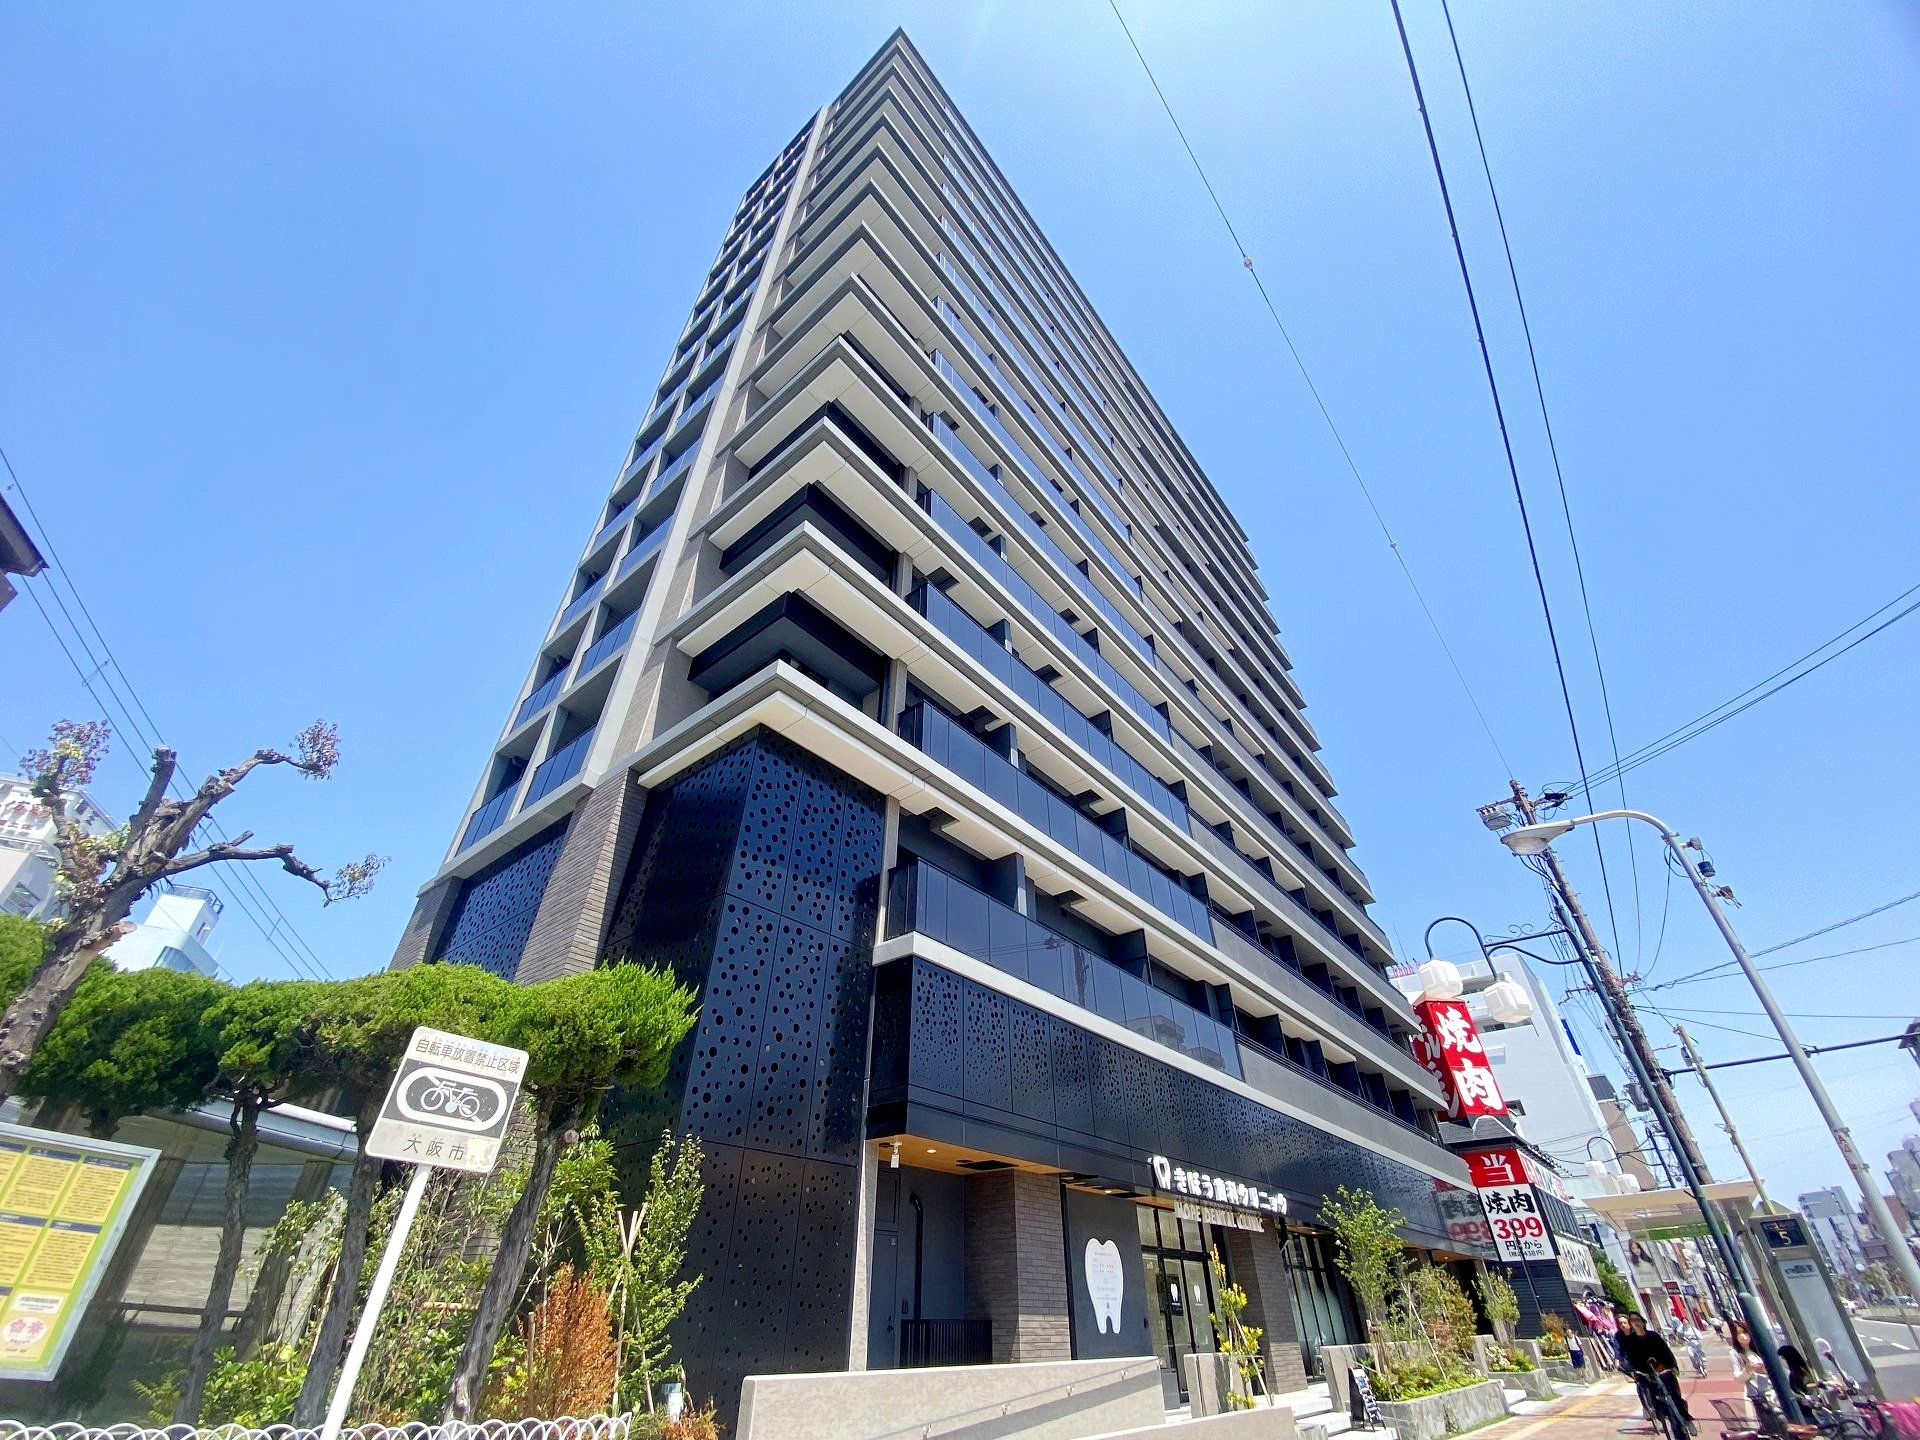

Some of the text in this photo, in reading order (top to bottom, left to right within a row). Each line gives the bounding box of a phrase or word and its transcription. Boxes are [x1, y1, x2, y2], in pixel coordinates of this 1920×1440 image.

[415, 1038, 521, 1075] 自転車放置禁止区域
[1435, 1005, 1503, 1110] 焼肉
[402, 1137, 465, 1161] 大阪市
[1468, 1153, 1515, 1183] 当
[1175, 1200, 1201, 1222] HOPE
[1202, 1205, 1237, 1228] DENTAL
[1484, 1188, 1536, 1215] 焼肉
[1493, 1216, 1544, 1239] 399
